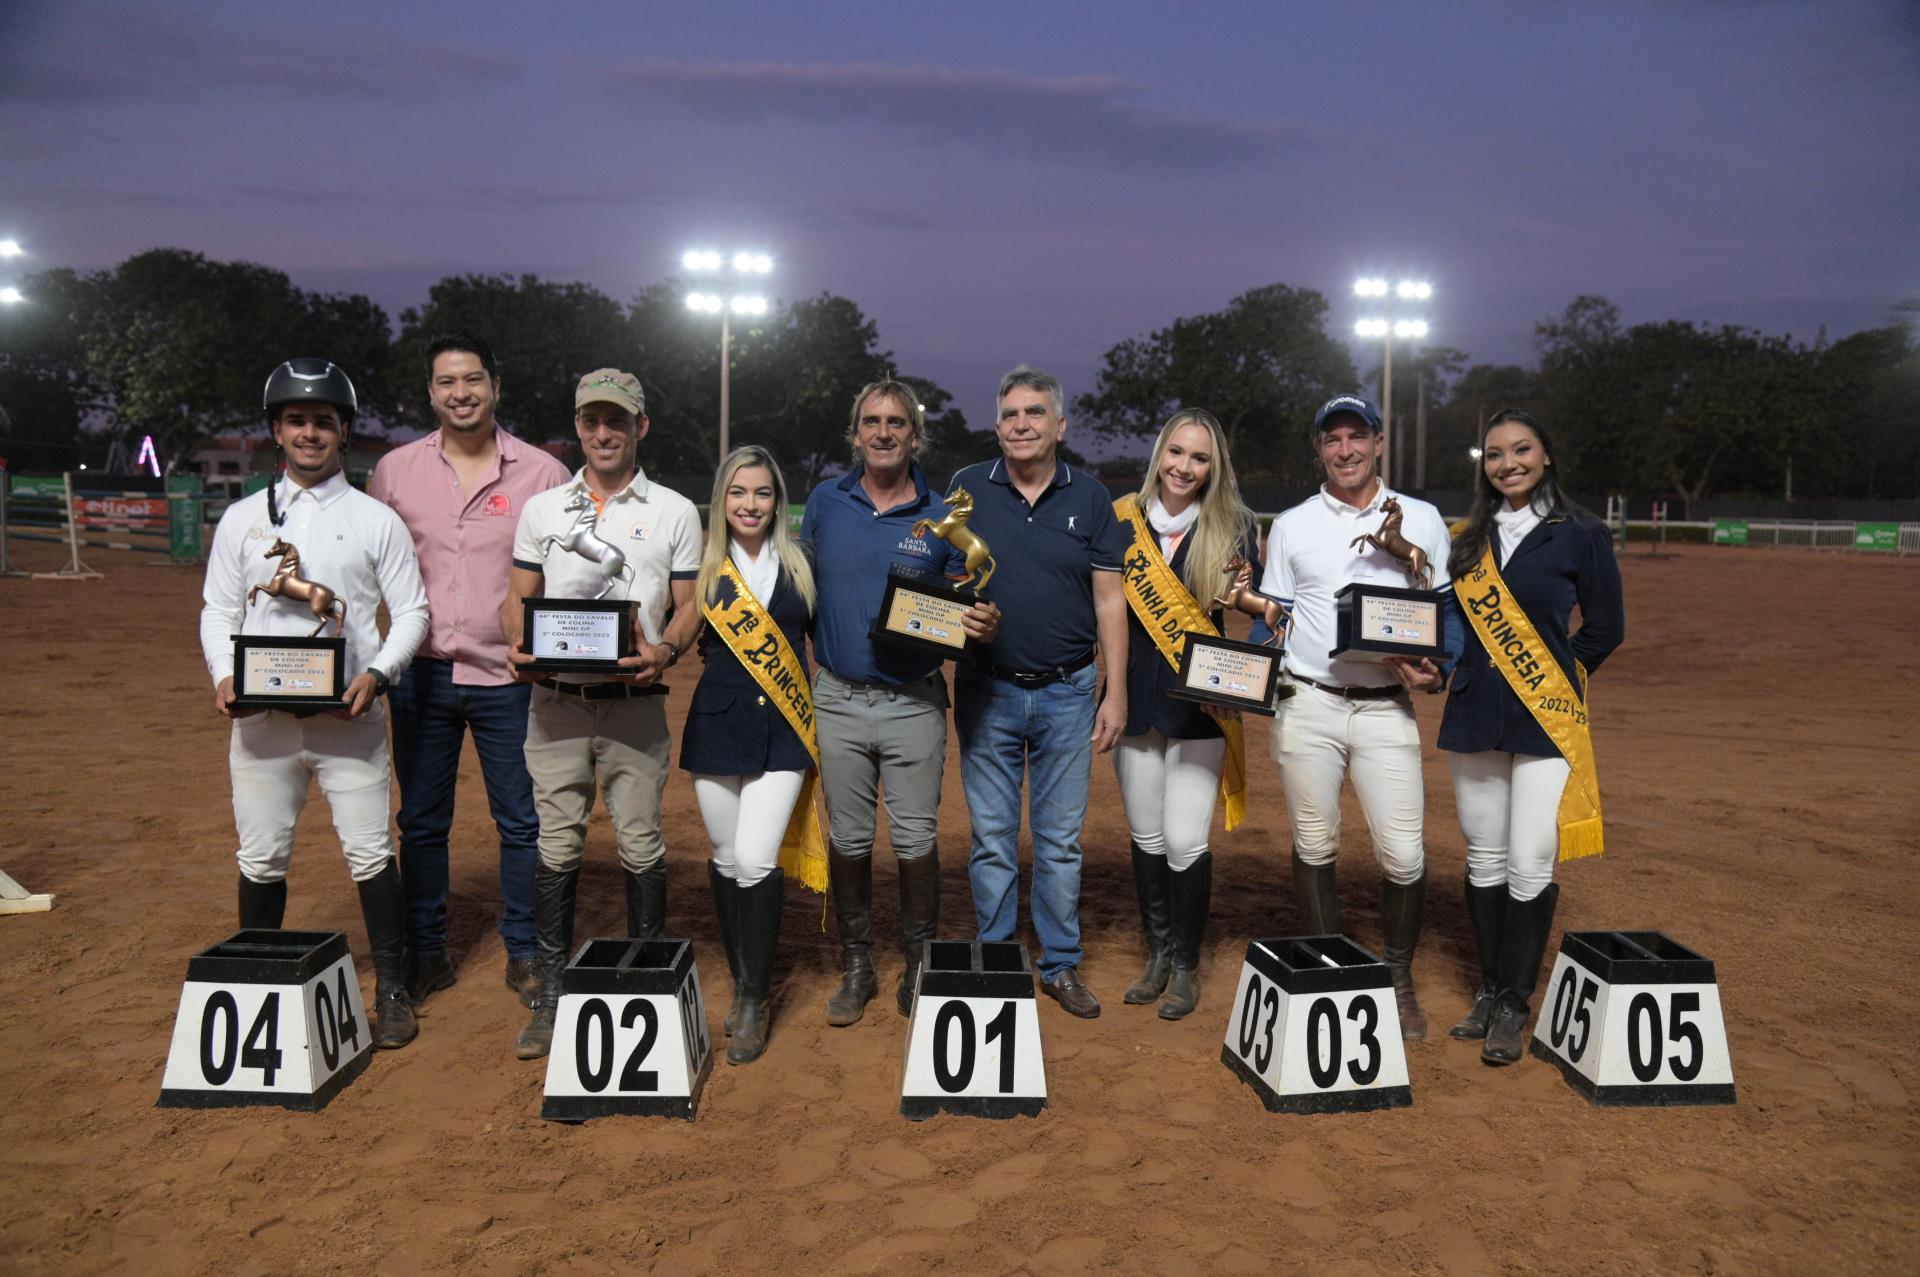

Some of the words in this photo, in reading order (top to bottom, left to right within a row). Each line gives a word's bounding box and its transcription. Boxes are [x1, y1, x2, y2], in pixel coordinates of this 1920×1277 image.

[635, 528, 642, 536] K
[908, 610, 944, 623] COLOCADO
[912, 594, 930, 603] FESTA
[944, 603, 964, 612] CAVAL
[925, 603, 950, 613] COLINA
[1122, 550, 1168, 621] RAINHA
[1162, 618, 1185, 643] DA
[1468, 585, 1546, 692] PRINCESA
[744, 632, 814, 732] PRINCESA
[1242, 656, 1267, 664] CAVALO
[200, 990, 282, 1086] 04
[315, 966, 359, 1072] 04
[576, 998, 658, 1092] 02
[933, 1000, 1016, 1093] 01
[1239, 973, 1279, 1075] 03
[1307, 994, 1381, 1089] 03
[1551, 966, 1598, 1063] 05
[1627, 992, 1703, 1082] 05
